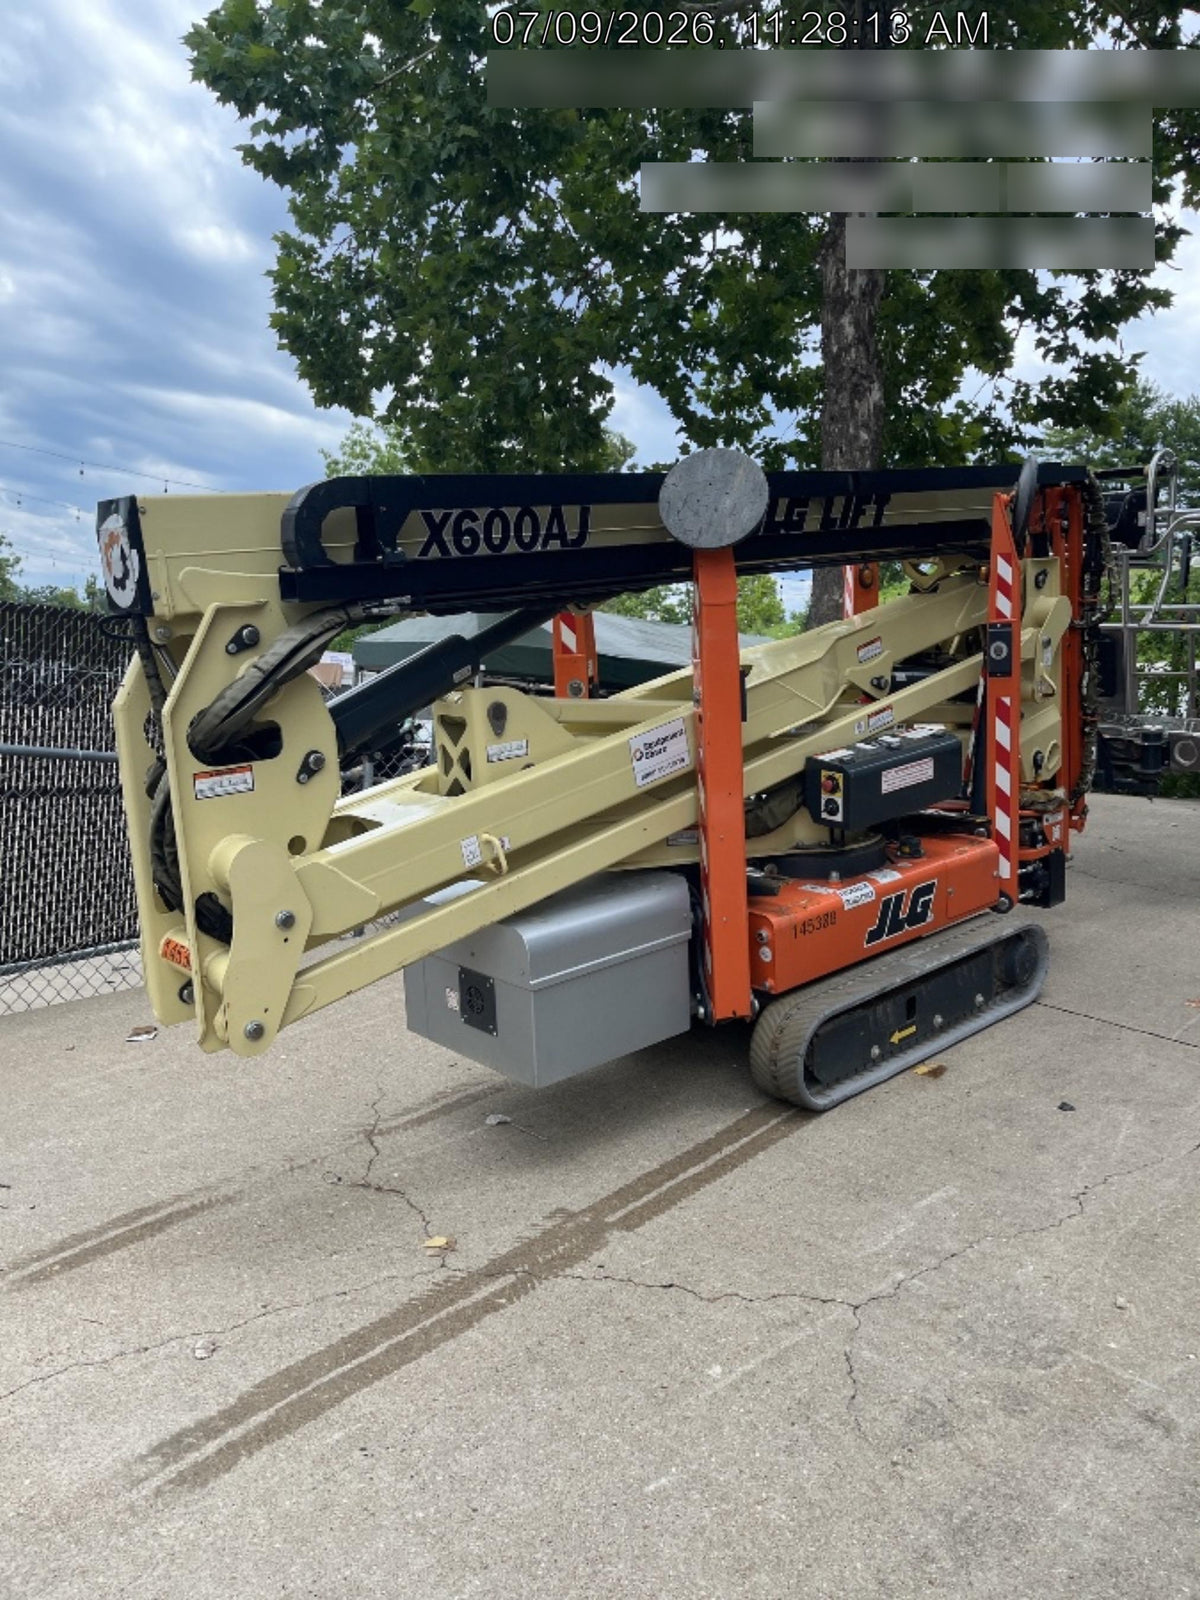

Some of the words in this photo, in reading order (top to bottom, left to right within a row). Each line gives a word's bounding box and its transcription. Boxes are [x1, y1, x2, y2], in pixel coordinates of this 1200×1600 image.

[416, 504, 592, 559] X600AJ
[760, 496, 813, 535] LG
[816, 493, 887, 532] LIFT
[864, 878, 938, 948] JLG
